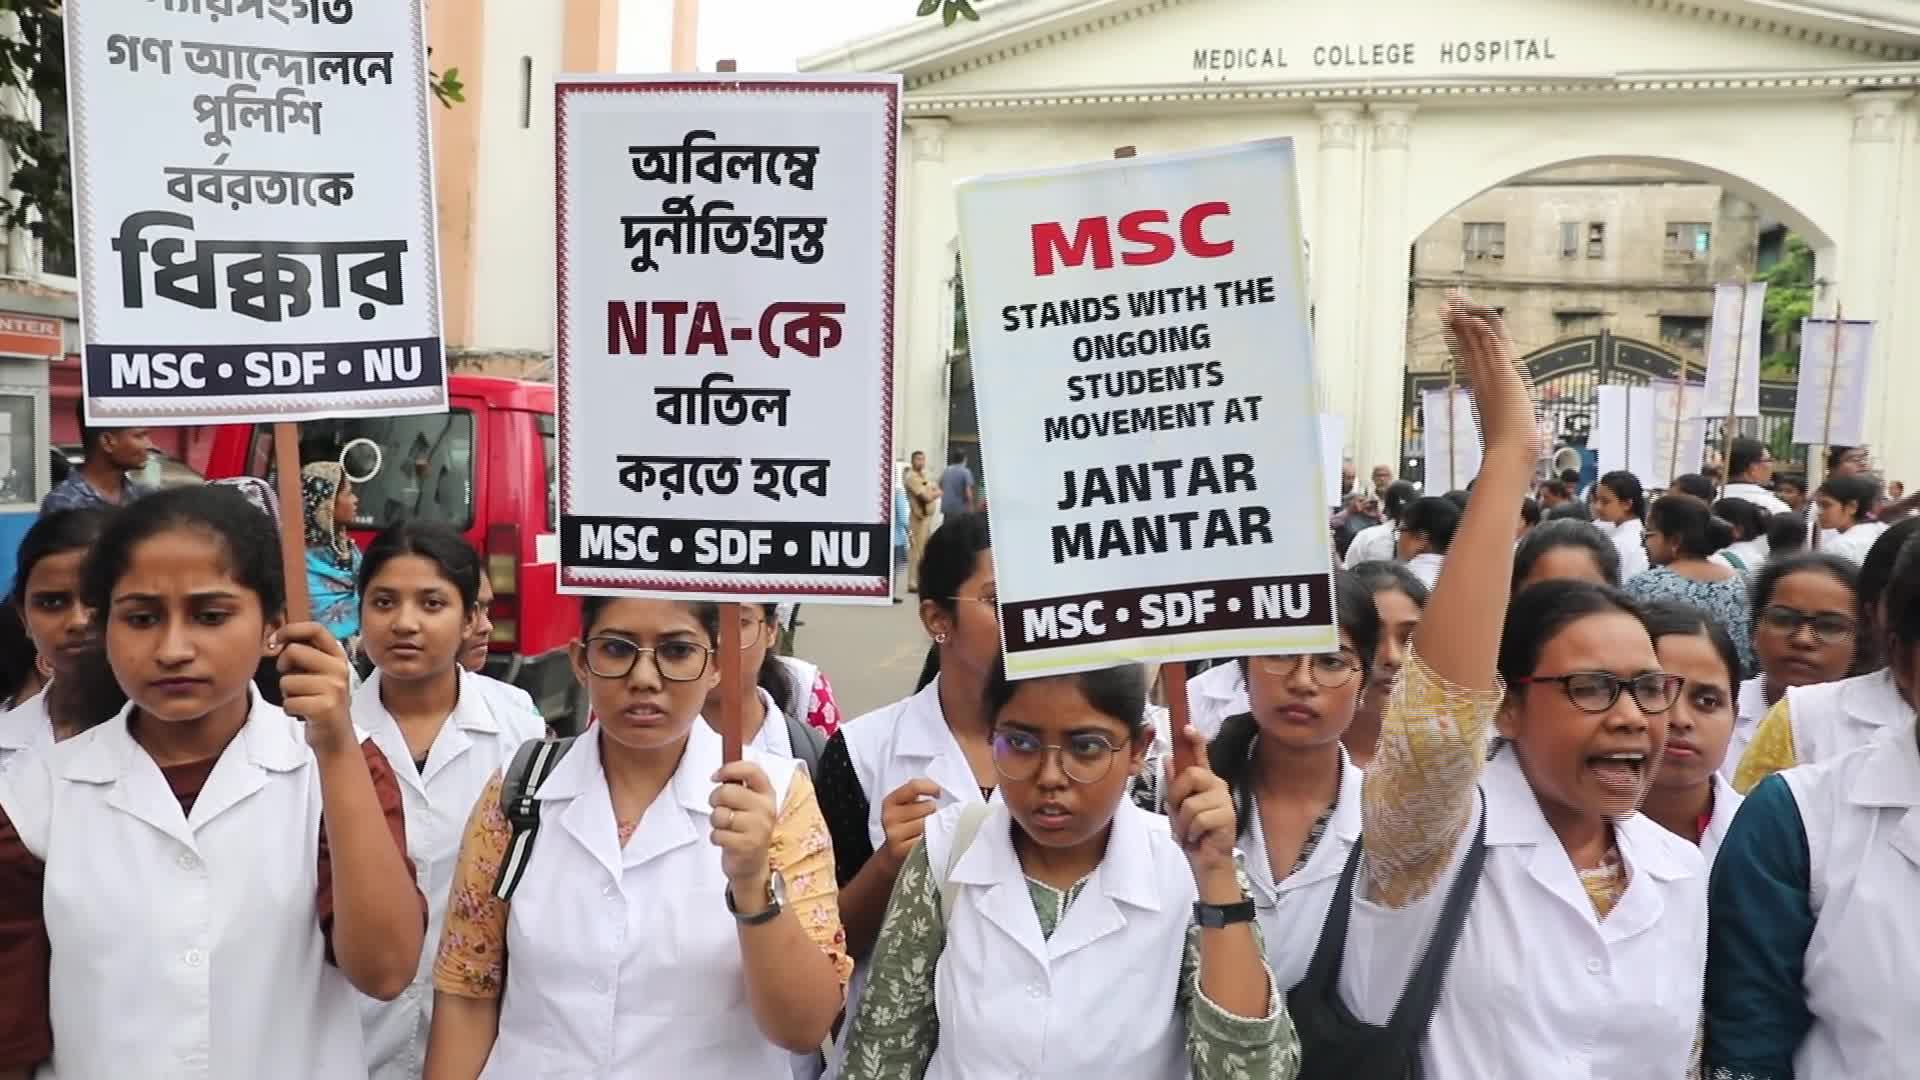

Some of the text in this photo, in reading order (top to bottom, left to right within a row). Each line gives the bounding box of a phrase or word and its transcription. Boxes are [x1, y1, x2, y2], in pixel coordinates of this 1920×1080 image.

[106, 33, 395, 85] গণ আন্দোলনে
[1192, 38, 1556, 70] MEDICAL COLLEGE HOSPITAL
[193, 83, 323, 147] পুলিশি
[164, 153, 356, 211] বর্বরতাকে
[628, 129, 820, 191] অবিলম্বে
[620, 194, 828, 273] দুর্নীতিগ্রস্ত
[1030, 200, 1235, 277] MSC
[111, 210, 409, 322] ধিক্কার
[607, 299, 847, 359] NTA-কে
[1001, 276, 1277, 332] STANDS WITH THE
[111, 346, 423, 390] MSC SDF NU
[1072, 323, 1212, 364] ONGOING
[653, 371, 791, 427] বাতিল
[1066, 360, 1225, 402] STUDENTS
[1043, 395, 1264, 444] MOVEMENT AT
[616, 455, 831, 502] করতে হবে
[1056, 453, 1258, 511] JANTAR
[579, 523, 870, 568] MSC SDF NU
[1050, 505, 1275, 565] MANTAR
[1022, 583, 1312, 643] MSC SDF NU
